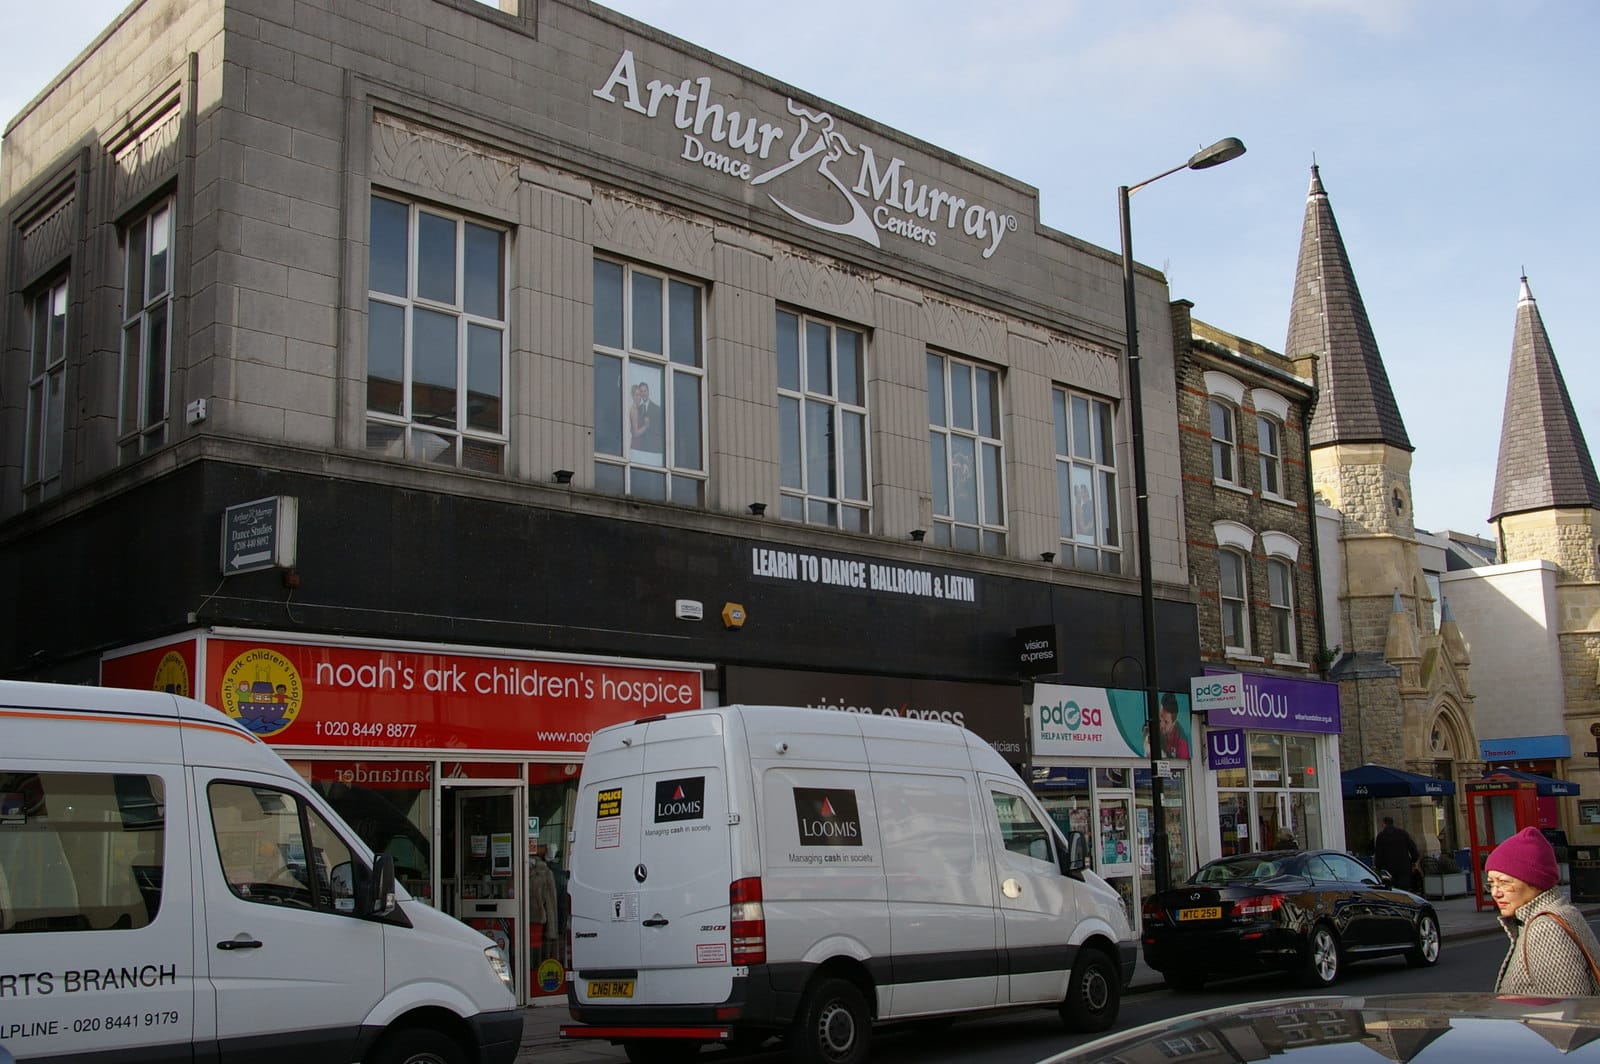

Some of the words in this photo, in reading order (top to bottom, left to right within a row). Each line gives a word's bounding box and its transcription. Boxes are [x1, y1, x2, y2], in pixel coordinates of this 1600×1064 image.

[592, 49, 784, 160] Arthur
[680, 134, 751, 181] Dance
[873, 205, 937, 246] Centers
[752, 548, 798, 580] LEARN
[800, 554, 819, 583] TO
[821, 557, 867, 588] DANCE
[869, 564, 932, 597] BALLROOM
[933, 577, 943, 598] &
[944, 574, 975, 601] LATIN
[1024, 639, 1049, 650] vision
[231, 661, 245, 675] ark
[246, 652, 290, 672] children's
[1020, 650, 1054, 662] express
[316, 658, 414, 690] noah's
[423, 664, 467, 692] ark
[474, 666, 595, 699] children's
[602, 673, 693, 708] hospice
[316, 720, 322, 735] t
[324, 722, 350, 736] 020
[352, 722, 384, 736] 8449
[387, 723, 418, 738] 8877
[537, 730, 594, 743] www.noa
[1041, 732, 1056, 740] HELP
[1060, 733, 1072, 741] VET
[1072, 733, 1087, 741] HELP
[1087, 733, 1092, 741] A
[1092, 734, 1102, 742] PET
[599, 790, 622, 801] POLICE
[658, 800, 701, 817] LOOMIS
[645, 826, 670, 837] Managing
[670, 826, 684, 834] cash
[691, 824, 711, 833] society
[802, 818, 857, 837] LOOMIS
[788, 853, 823, 864] Managing
[824, 853, 842, 862] cash
[850, 854, 873, 863] society
[64, 963, 176, 993] BRANCH
[0, 1020, 59, 1039] LPLINE
[73, 1018, 101, 1032] 020
[105, 1014, 139, 1030] 8441
[144, 1011, 179, 1026] 9179
